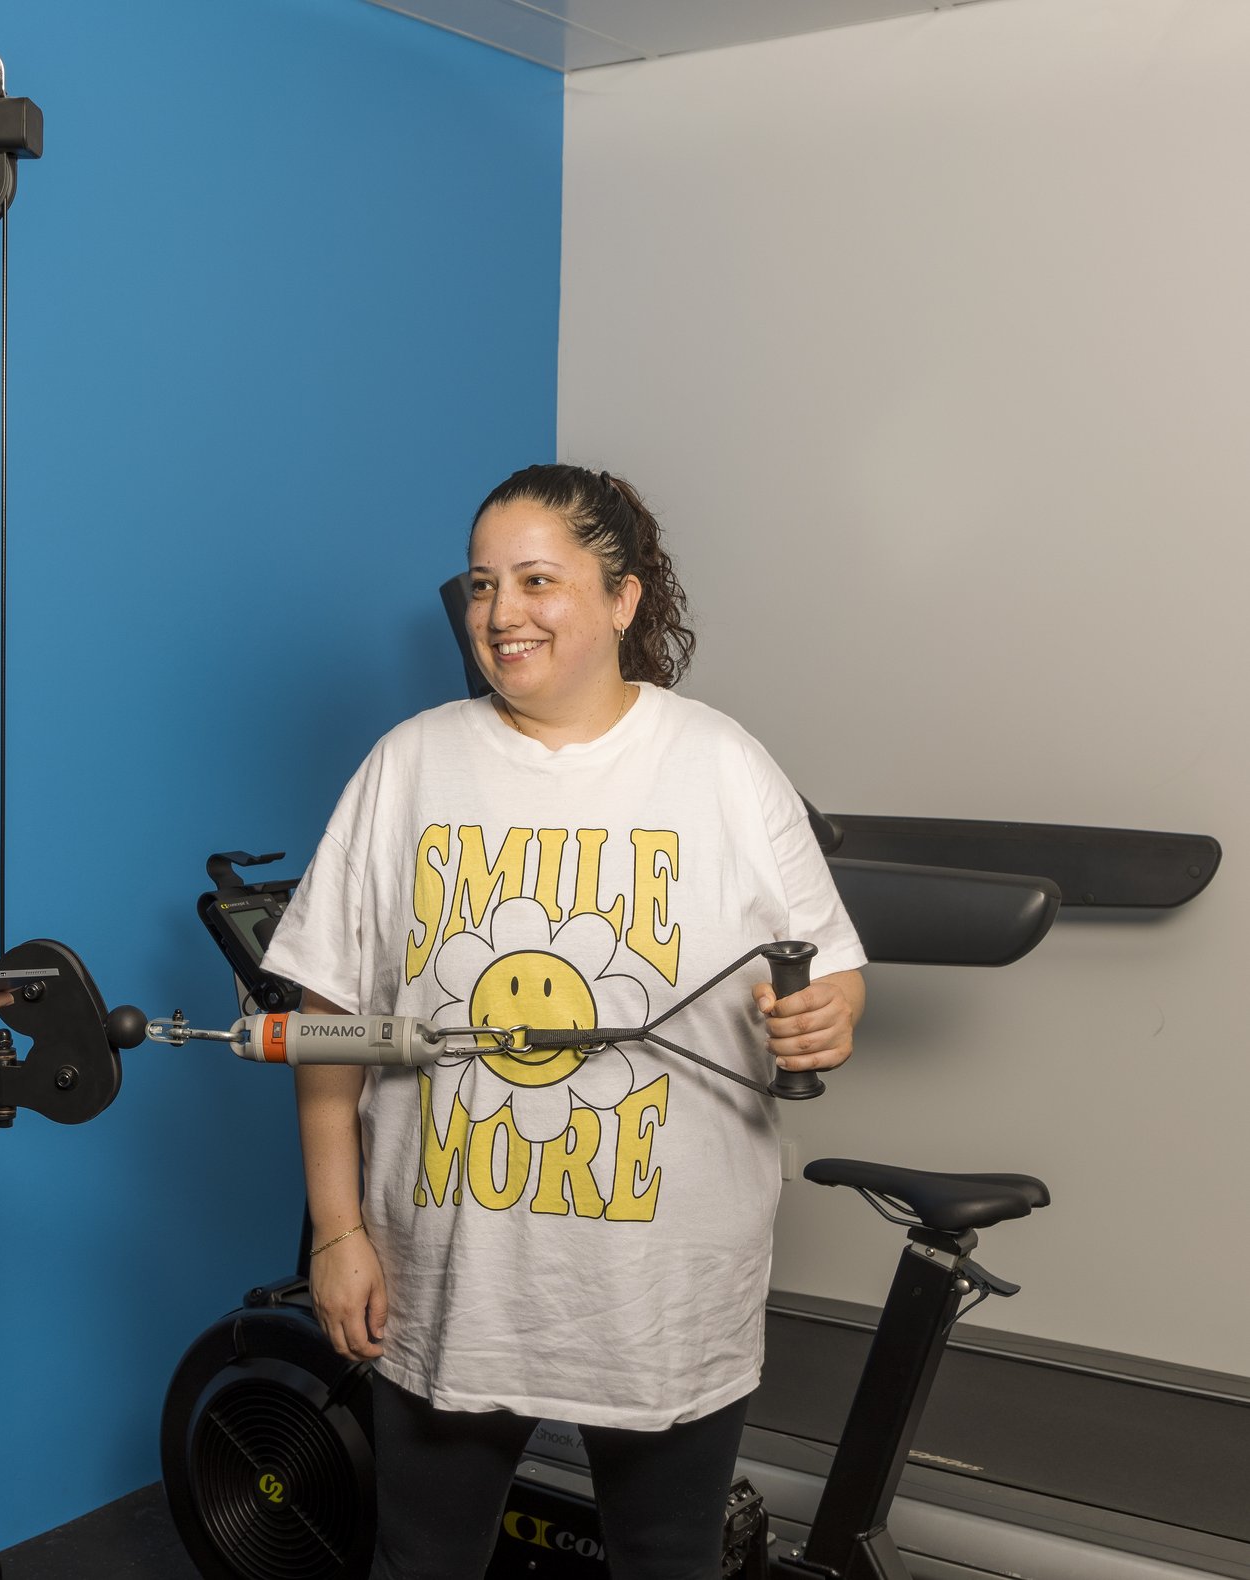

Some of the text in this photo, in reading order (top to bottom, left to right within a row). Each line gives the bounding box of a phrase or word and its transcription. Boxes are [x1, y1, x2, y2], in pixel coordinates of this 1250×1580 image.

[406, 824, 681, 987] SMILE
[300, 1025, 366, 1038] DYNAMO
[413, 1070, 669, 1222] MORE
[535, 1429, 573, 1447] Shock
